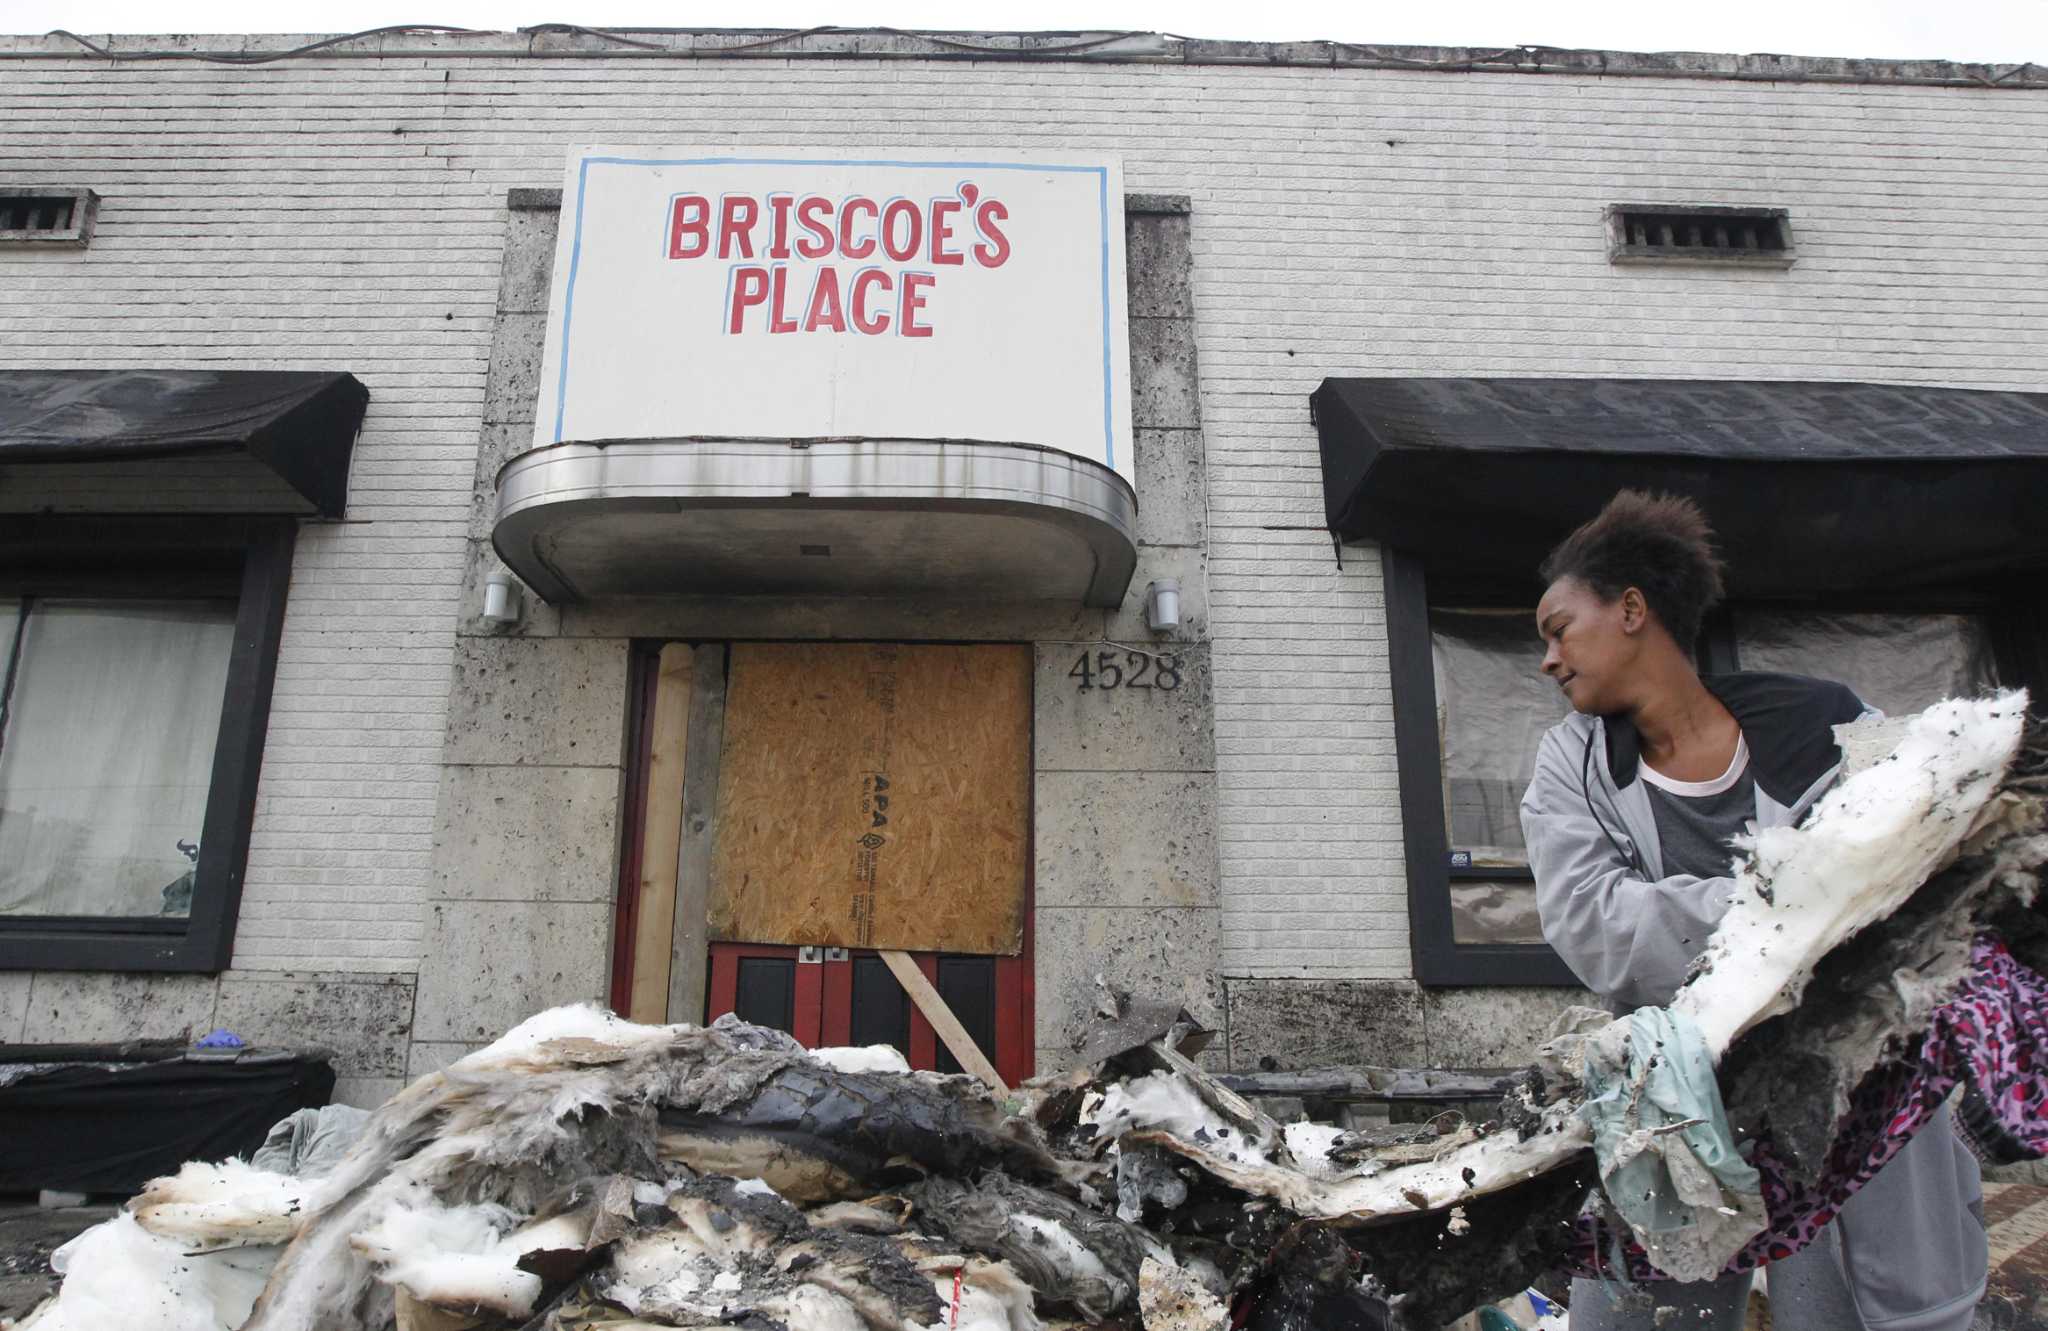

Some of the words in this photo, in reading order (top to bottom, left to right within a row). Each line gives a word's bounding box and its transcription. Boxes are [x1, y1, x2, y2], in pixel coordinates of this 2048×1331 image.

[665, 182, 1010, 268] BRISCOE'S
[725, 264, 936, 338] PLACE
[1068, 651, 1181, 690] 4528
[871, 775, 890, 828] APA
